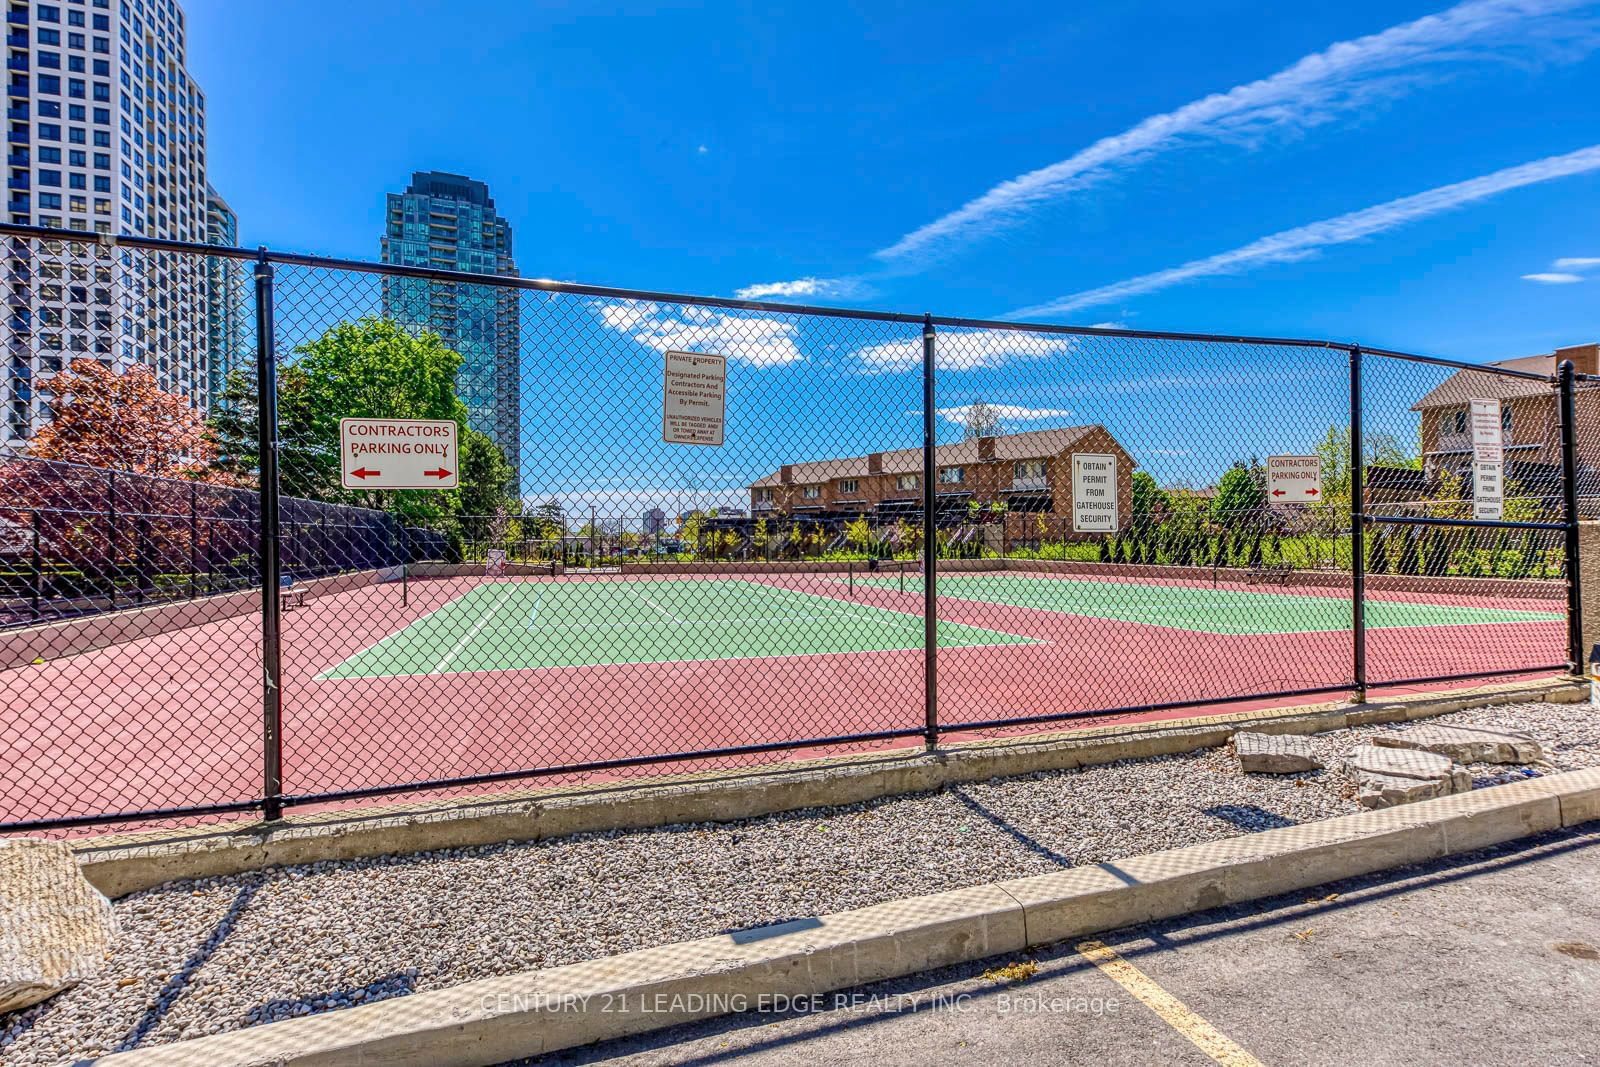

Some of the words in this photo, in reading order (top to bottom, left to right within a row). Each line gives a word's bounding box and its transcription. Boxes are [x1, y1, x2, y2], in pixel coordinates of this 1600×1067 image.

[694, 357, 722, 365] PROPERTY
[667, 370, 700, 379] Designated
[702, 374, 724, 382] Parking
[700, 392, 722, 400] Parking
[349, 425, 450, 437] CONTRACTORS
[351, 443, 411, 454] PARKING
[414, 444, 448, 454] ONLY
[1077, 502, 1114, 510] GATEHOUSE
